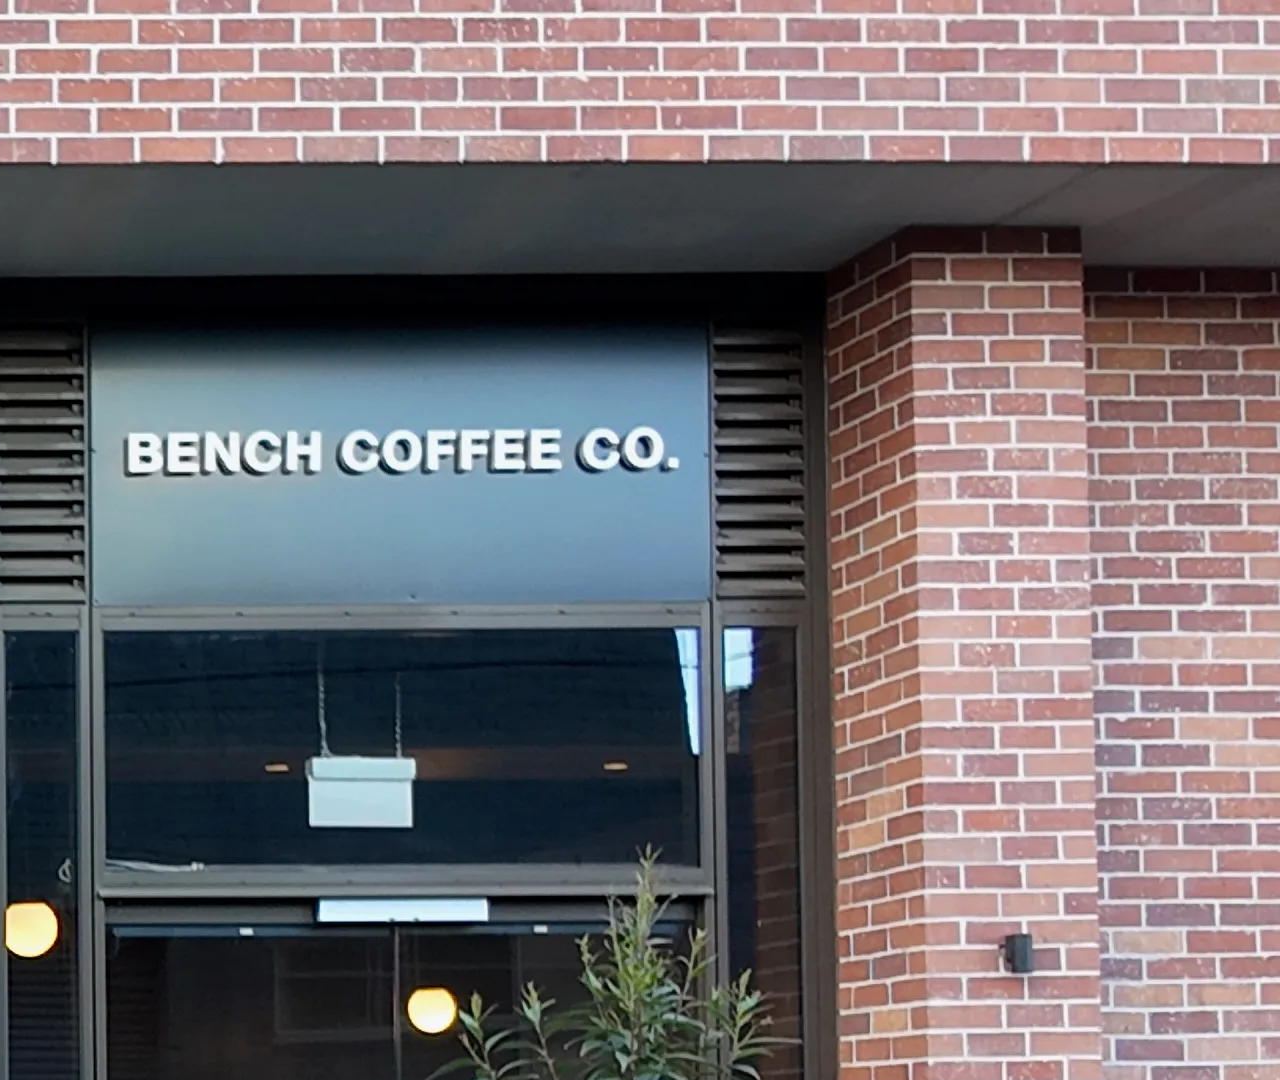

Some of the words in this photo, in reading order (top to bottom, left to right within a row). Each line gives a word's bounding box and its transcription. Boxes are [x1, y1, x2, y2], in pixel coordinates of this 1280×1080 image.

[125, 430, 322, 475] BENCH
[336, 428, 562, 475] COFFEE
[575, 426, 680, 473] CO.
